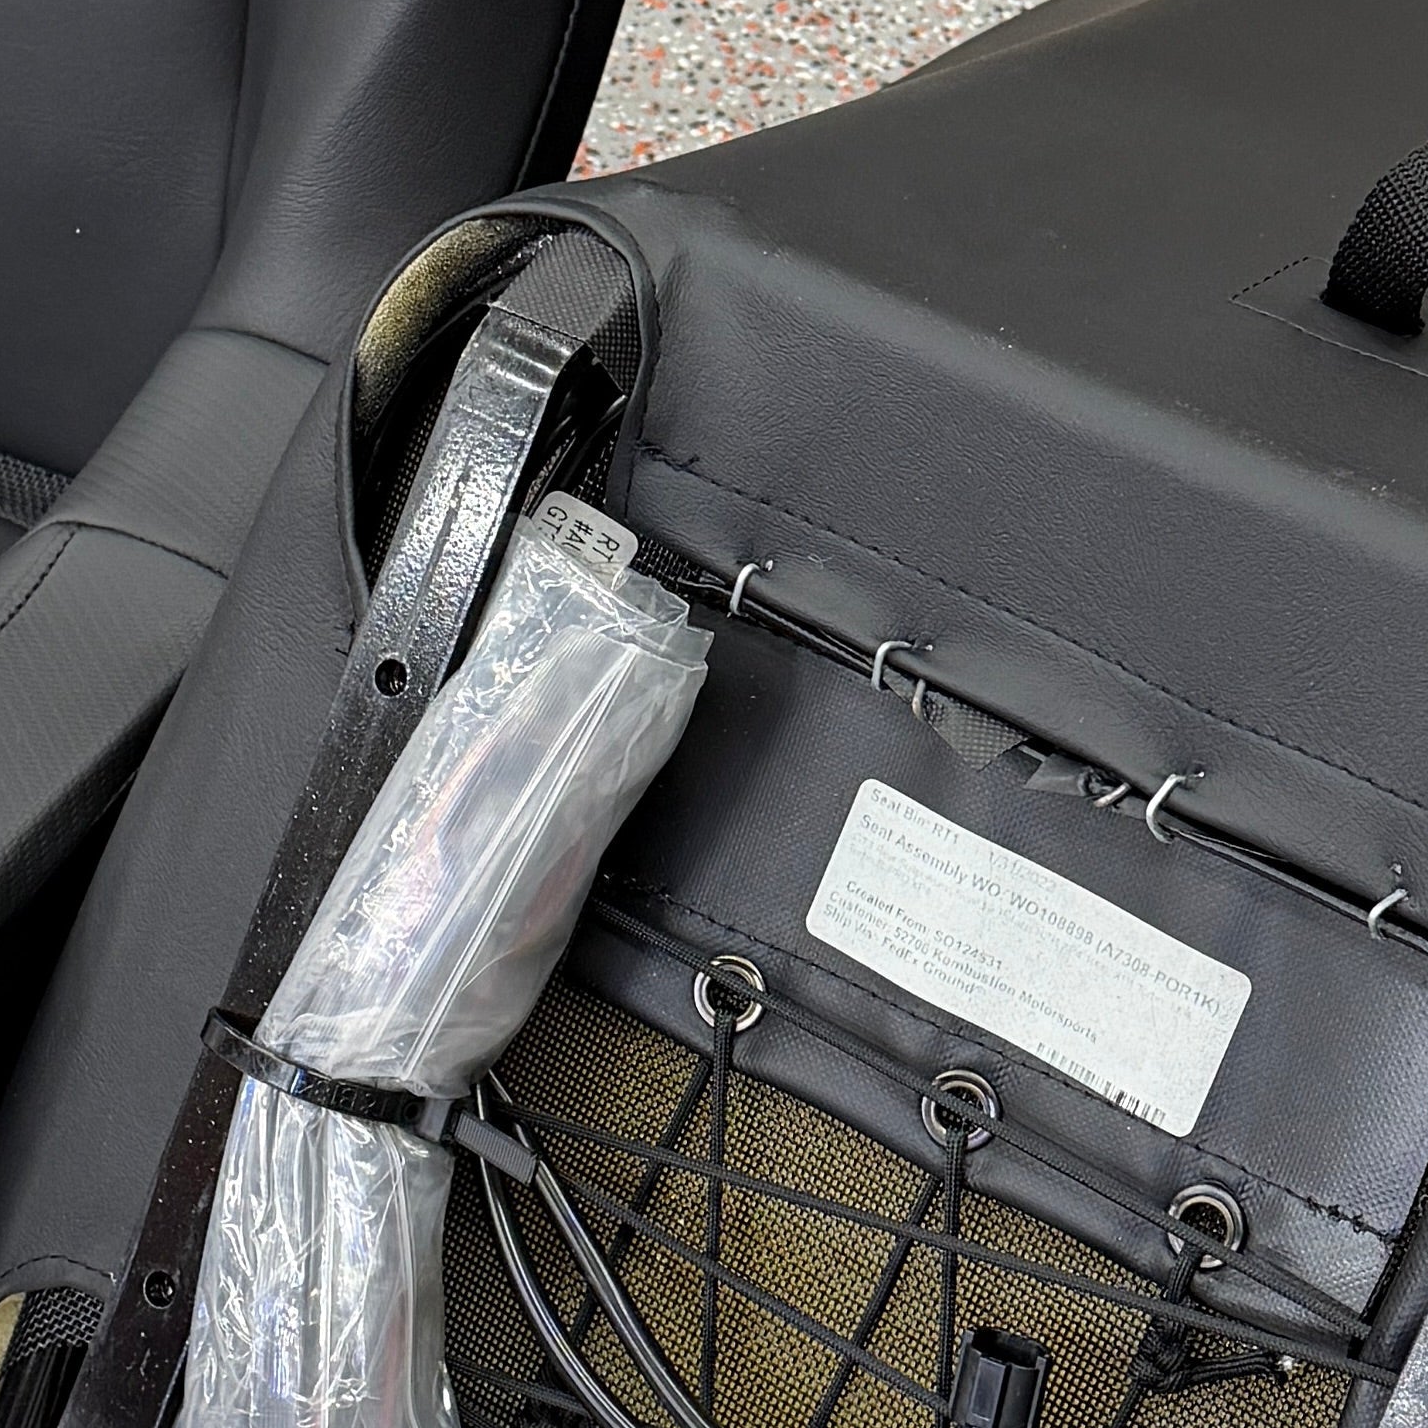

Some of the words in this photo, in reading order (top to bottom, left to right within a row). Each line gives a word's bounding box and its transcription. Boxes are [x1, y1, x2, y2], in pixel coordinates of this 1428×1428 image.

[870, 787, 901, 814] Seat
[859, 813, 893, 842] Seat
[894, 833, 968, 885] Assembly
[845, 879, 894, 915] Created
[1017, 989, 1097, 1045] Motorsports
